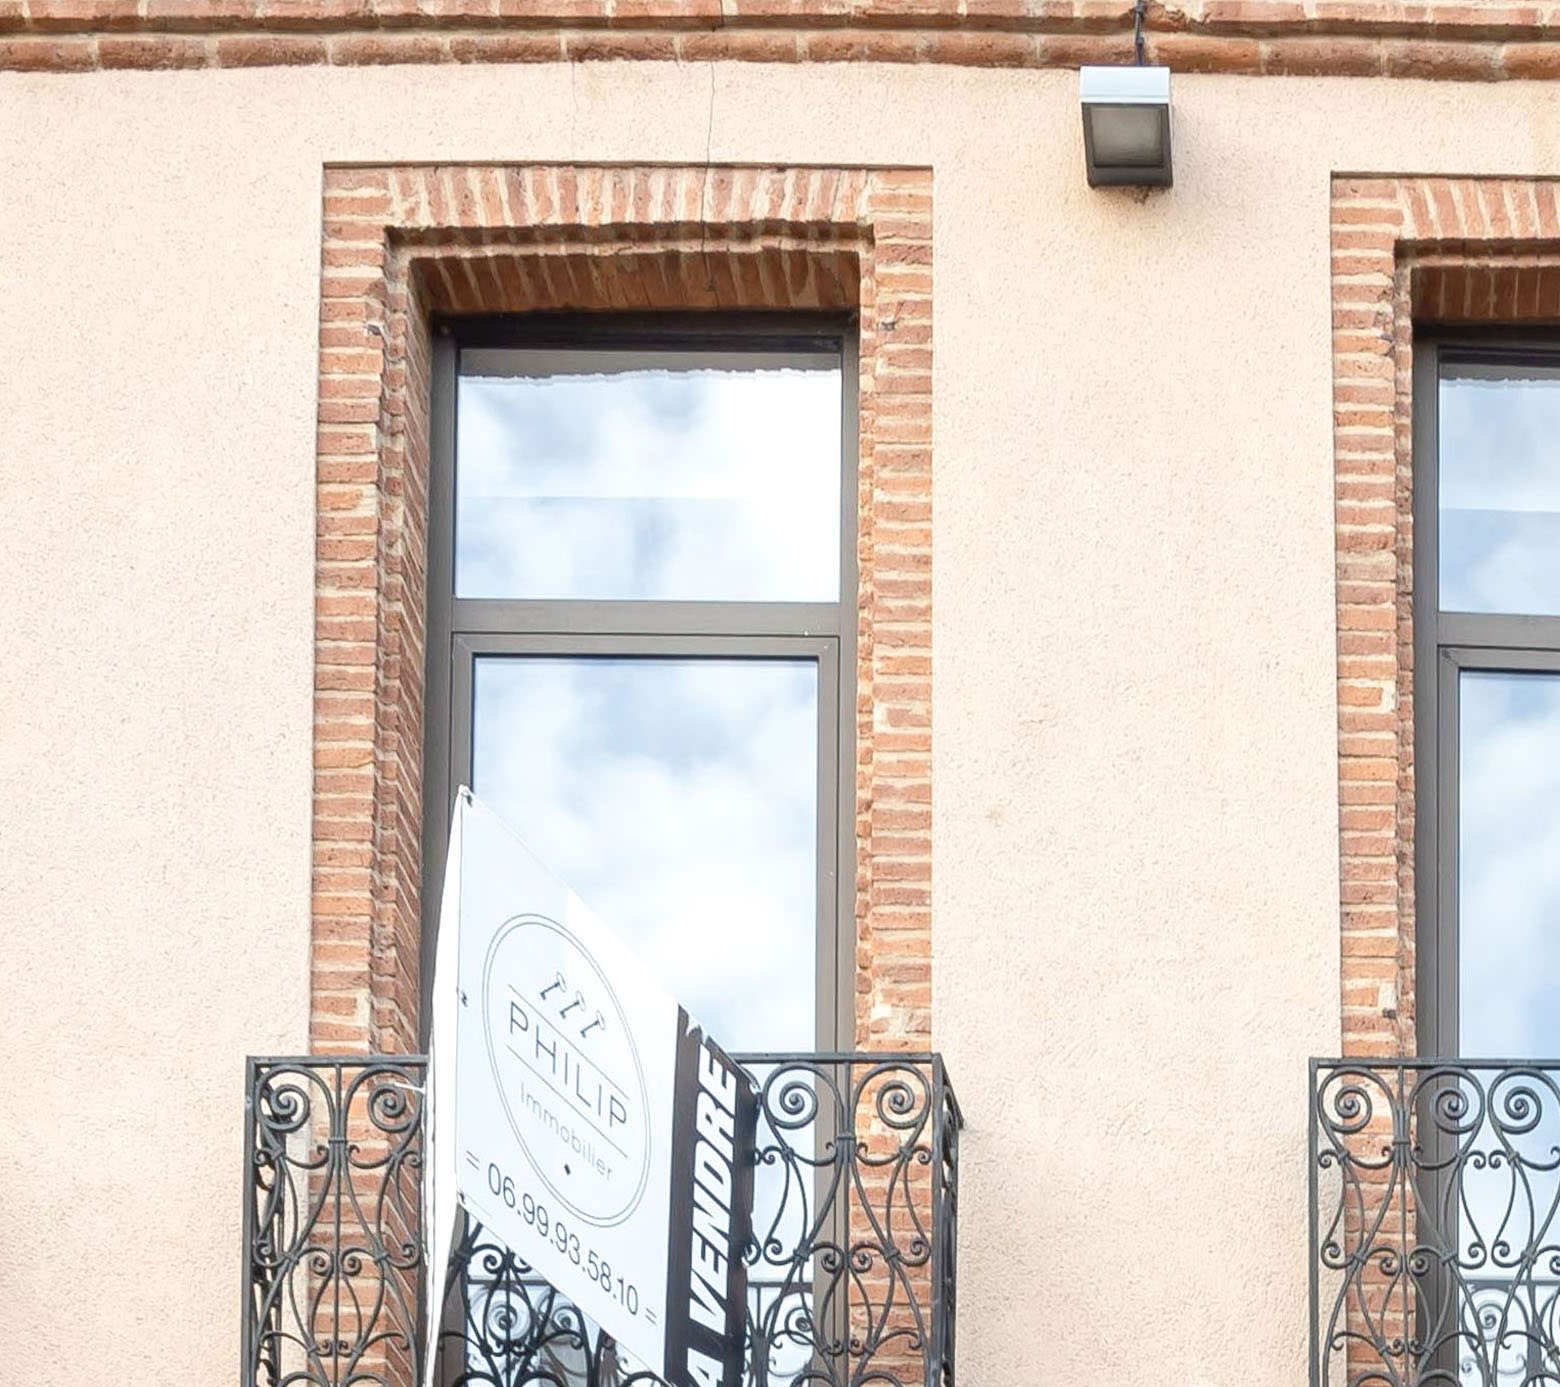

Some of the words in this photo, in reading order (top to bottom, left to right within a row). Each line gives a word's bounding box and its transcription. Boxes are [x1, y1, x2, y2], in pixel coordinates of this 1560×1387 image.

[509, 1001, 628, 1128] PHILIP
[487, 1162, 639, 1316] 06.99.93.58.10
[688, 1043, 738, 1336] VENDRE
